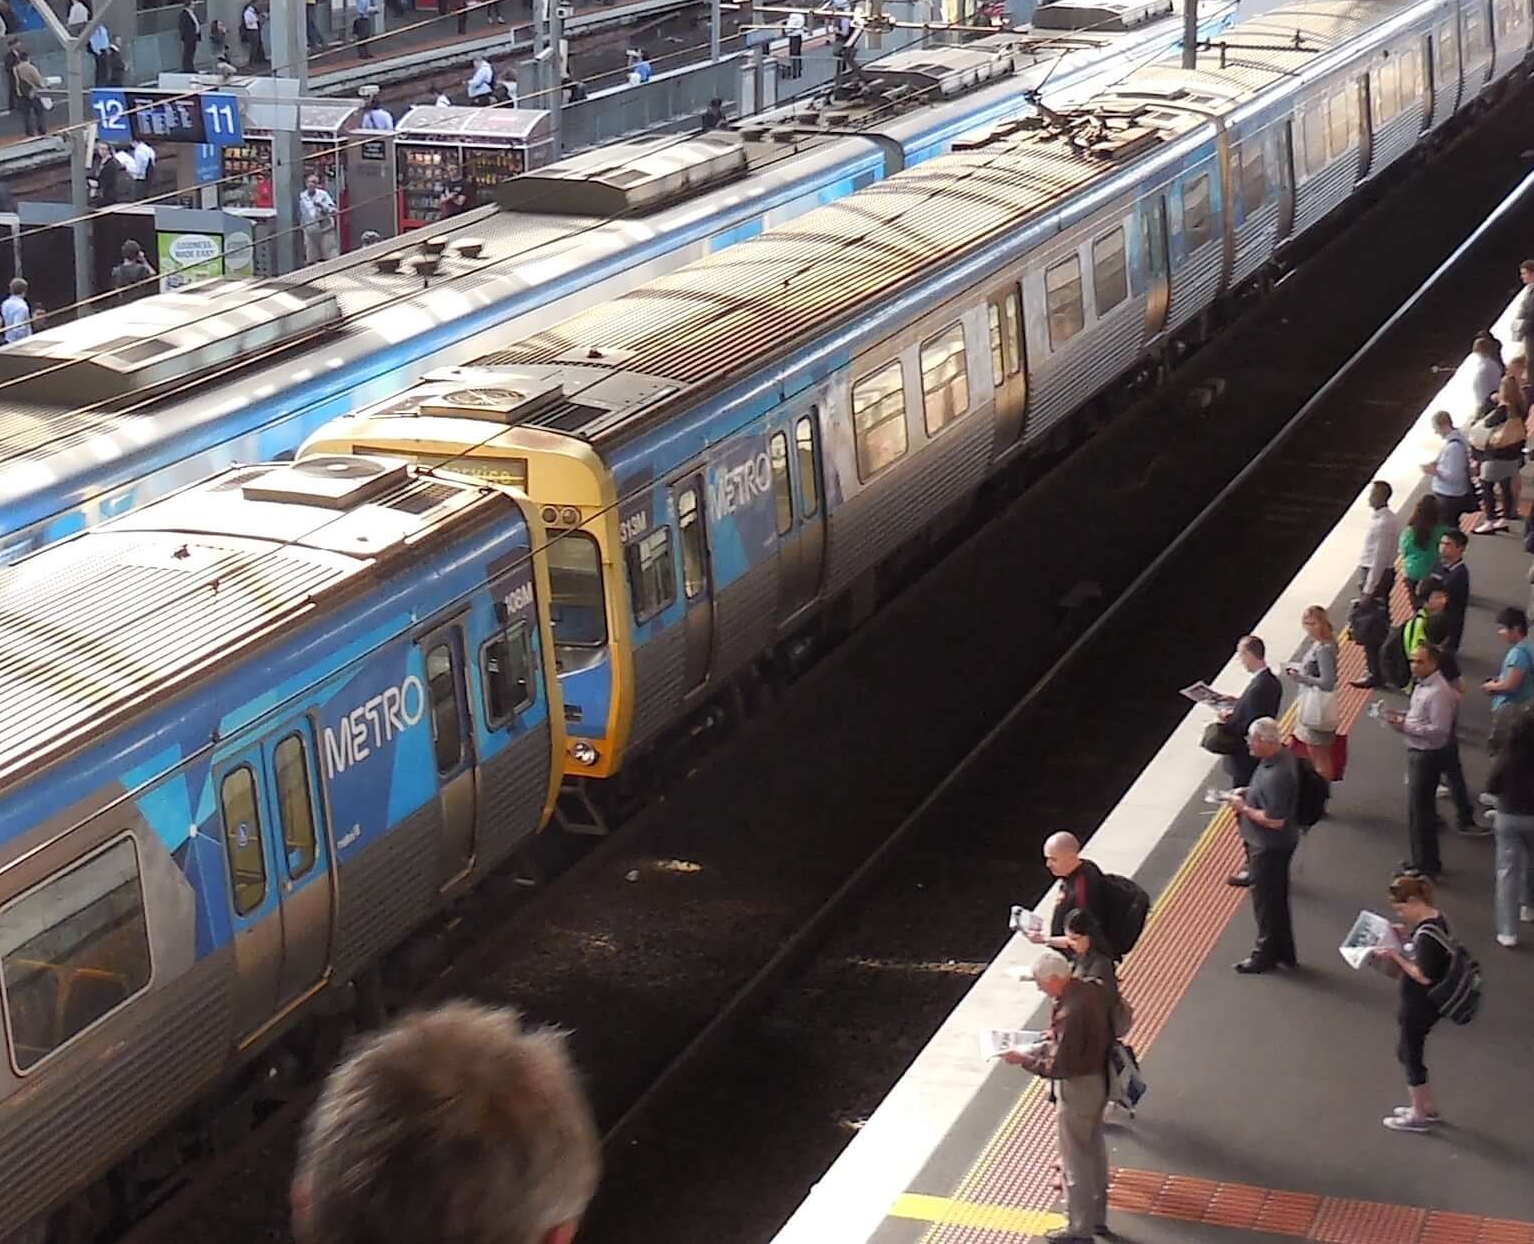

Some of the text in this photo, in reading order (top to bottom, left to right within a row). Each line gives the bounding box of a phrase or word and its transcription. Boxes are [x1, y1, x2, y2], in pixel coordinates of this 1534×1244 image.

[93, 99, 126, 129] 12
[205, 104, 234, 134] 11
[713, 452, 772, 520] METRO
[323, 674, 425, 779] METRO
